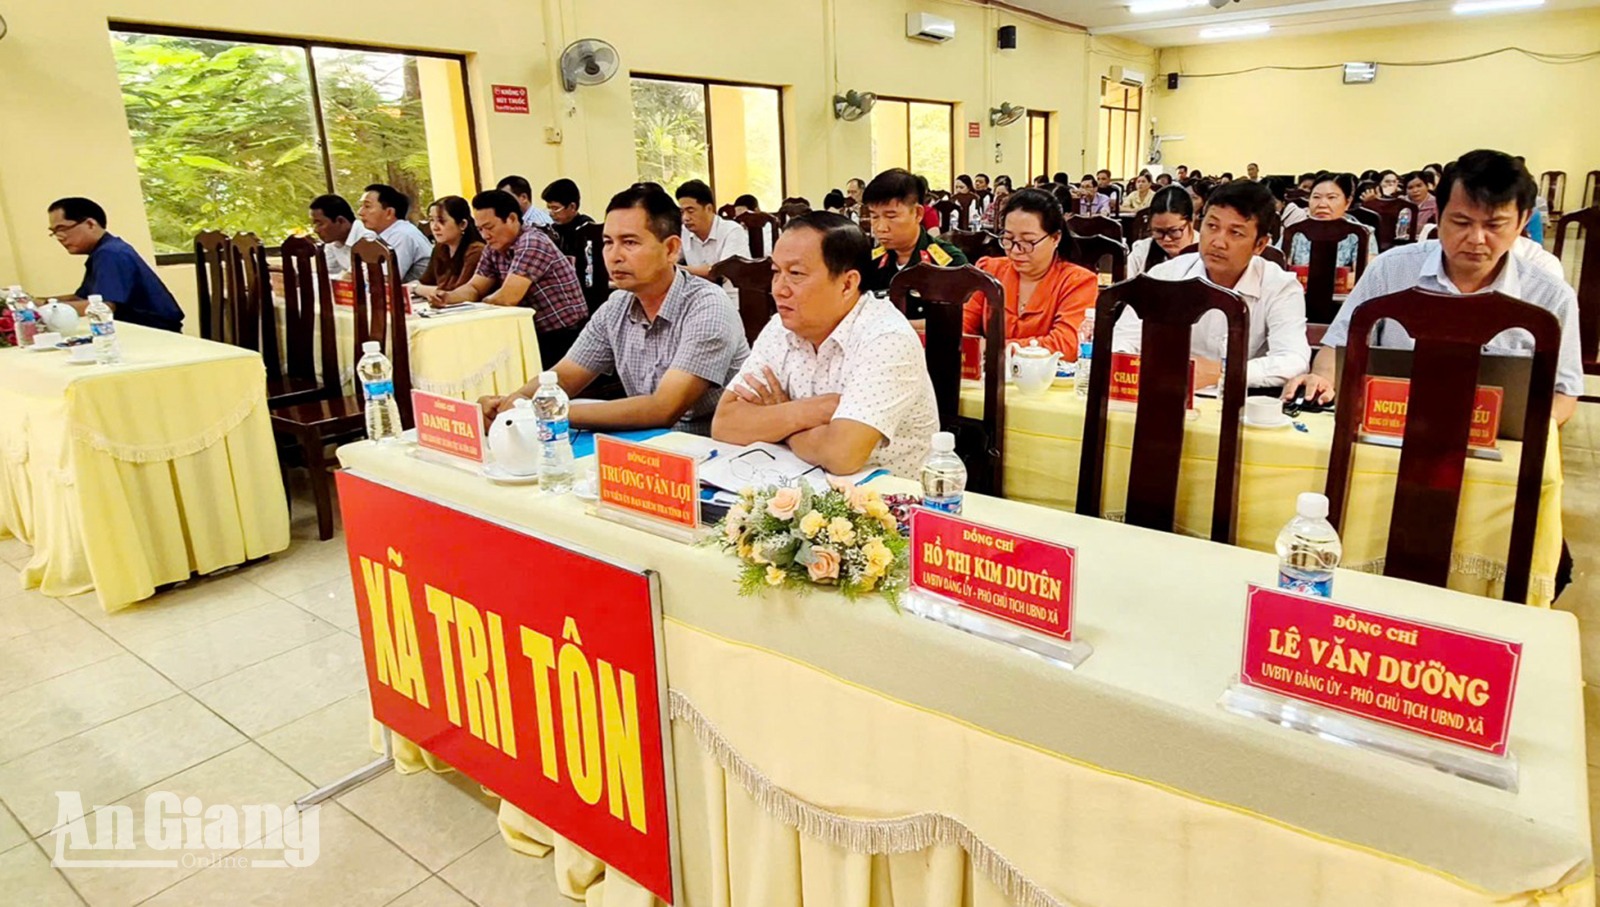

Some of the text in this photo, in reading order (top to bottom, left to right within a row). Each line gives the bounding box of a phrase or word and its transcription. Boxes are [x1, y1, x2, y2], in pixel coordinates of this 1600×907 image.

[1113, 371, 1139, 385] CHAU
[421, 411, 475, 440] DANH THA
[627, 451, 660, 468] ĐỒNG CHÍ
[601, 463, 691, 504] TRƯƠNG VĂN LỢI
[963, 527, 1014, 552] ĐỒNG CHÍ
[946, 548, 972, 581] THỊ
[974, 556, 1003, 585] KIM
[1005, 568, 1062, 602] DUYÊN
[943, 575, 962, 594] ĐẢNG
[977, 587, 992, 604] PHÓ
[993, 591, 1008, 608] CHỦ
[1008, 597, 1025, 614] TỊCH
[1025, 602, 1047, 620] UBND
[1047, 608, 1059, 625] XÃ
[1333, 612, 1419, 646] ĐỒNG CHÍ
[1268, 626, 1490, 706] LÊ VĂN DƯỠNG
[360, 546, 647, 834] XÃ TRI TÔN
[1261, 662, 1294, 683] UVBTV
[1294, 669, 1325, 692] ĐẢNG
[1326, 675, 1343, 696] ỦY
[1350, 685, 1374, 705] PHÓ
[1376, 692, 1400, 712] CHỦ
[1402, 699, 1428, 719] TỊCH
[1431, 708, 1464, 730] UBND
[1466, 716, 1485, 735] XÃ
